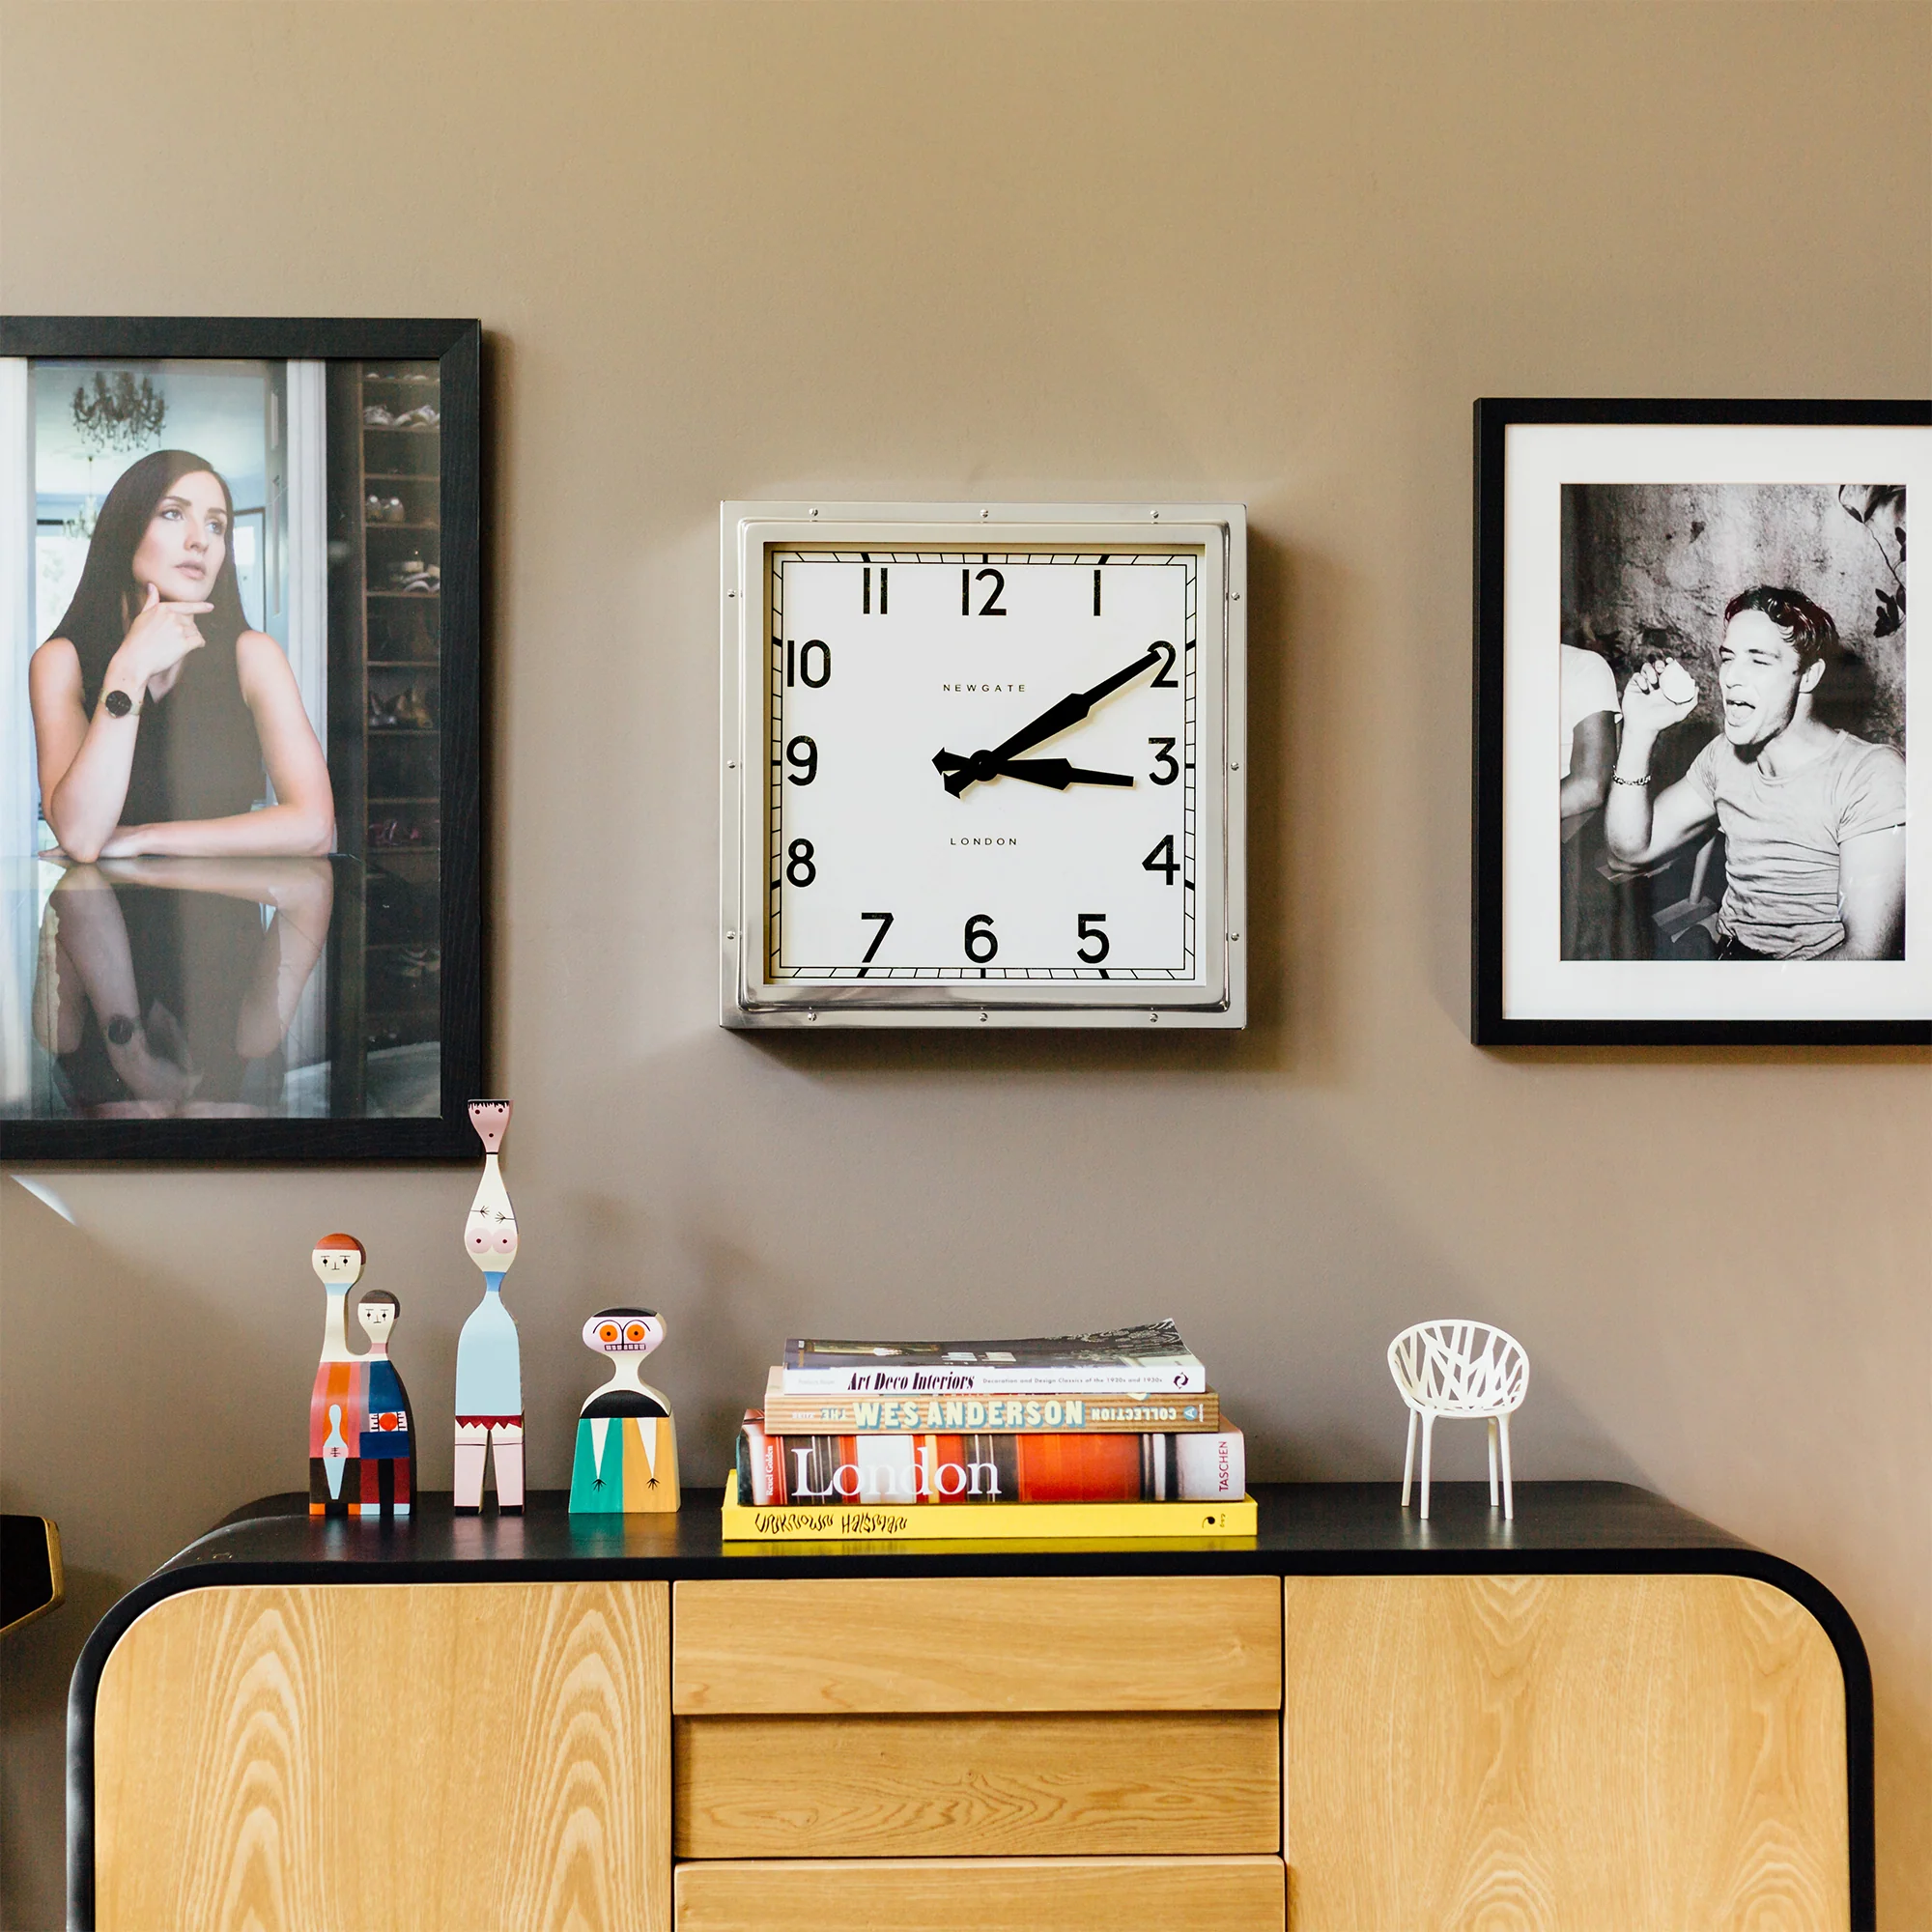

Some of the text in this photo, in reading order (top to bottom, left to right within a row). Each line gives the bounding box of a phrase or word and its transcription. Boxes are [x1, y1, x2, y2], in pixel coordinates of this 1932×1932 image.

[863, 567, 889, 615] 11
[961, 568, 1008, 616] 12
[1093, 569, 1101, 617] 1
[786, 639, 832, 689] 10
[943, 684, 1026, 693] NEWGATE
[1146, 639, 1179, 689] 2
[785, 735, 818, 786] 9
[1148, 737, 1179, 786] 3
[785, 838, 816, 888] 8
[950, 837, 1017, 846] LONDON
[1141, 834, 1181, 886] 4
[861, 912, 895, 963] 7
[964, 914, 999, 964] 6
[1076, 913, 1110, 964] 5
[847, 1372, 871, 1390] Art
[873, 1372, 909, 1390] Deco
[912, 1371, 975, 1390] Interiors
[1034, 1377, 1057, 1385] Design
[821, 1407, 848, 1421] THE
[853, 1401, 921, 1429] WES
[926, 1400, 1086, 1429] ANDERSON
[1091, 1406, 1178, 1422] COLLECTION
[765, 1445, 774, 1473] Golden
[790, 1446, 1003, 1496] London
[1218, 1440, 1230, 1492] TASCHEN
